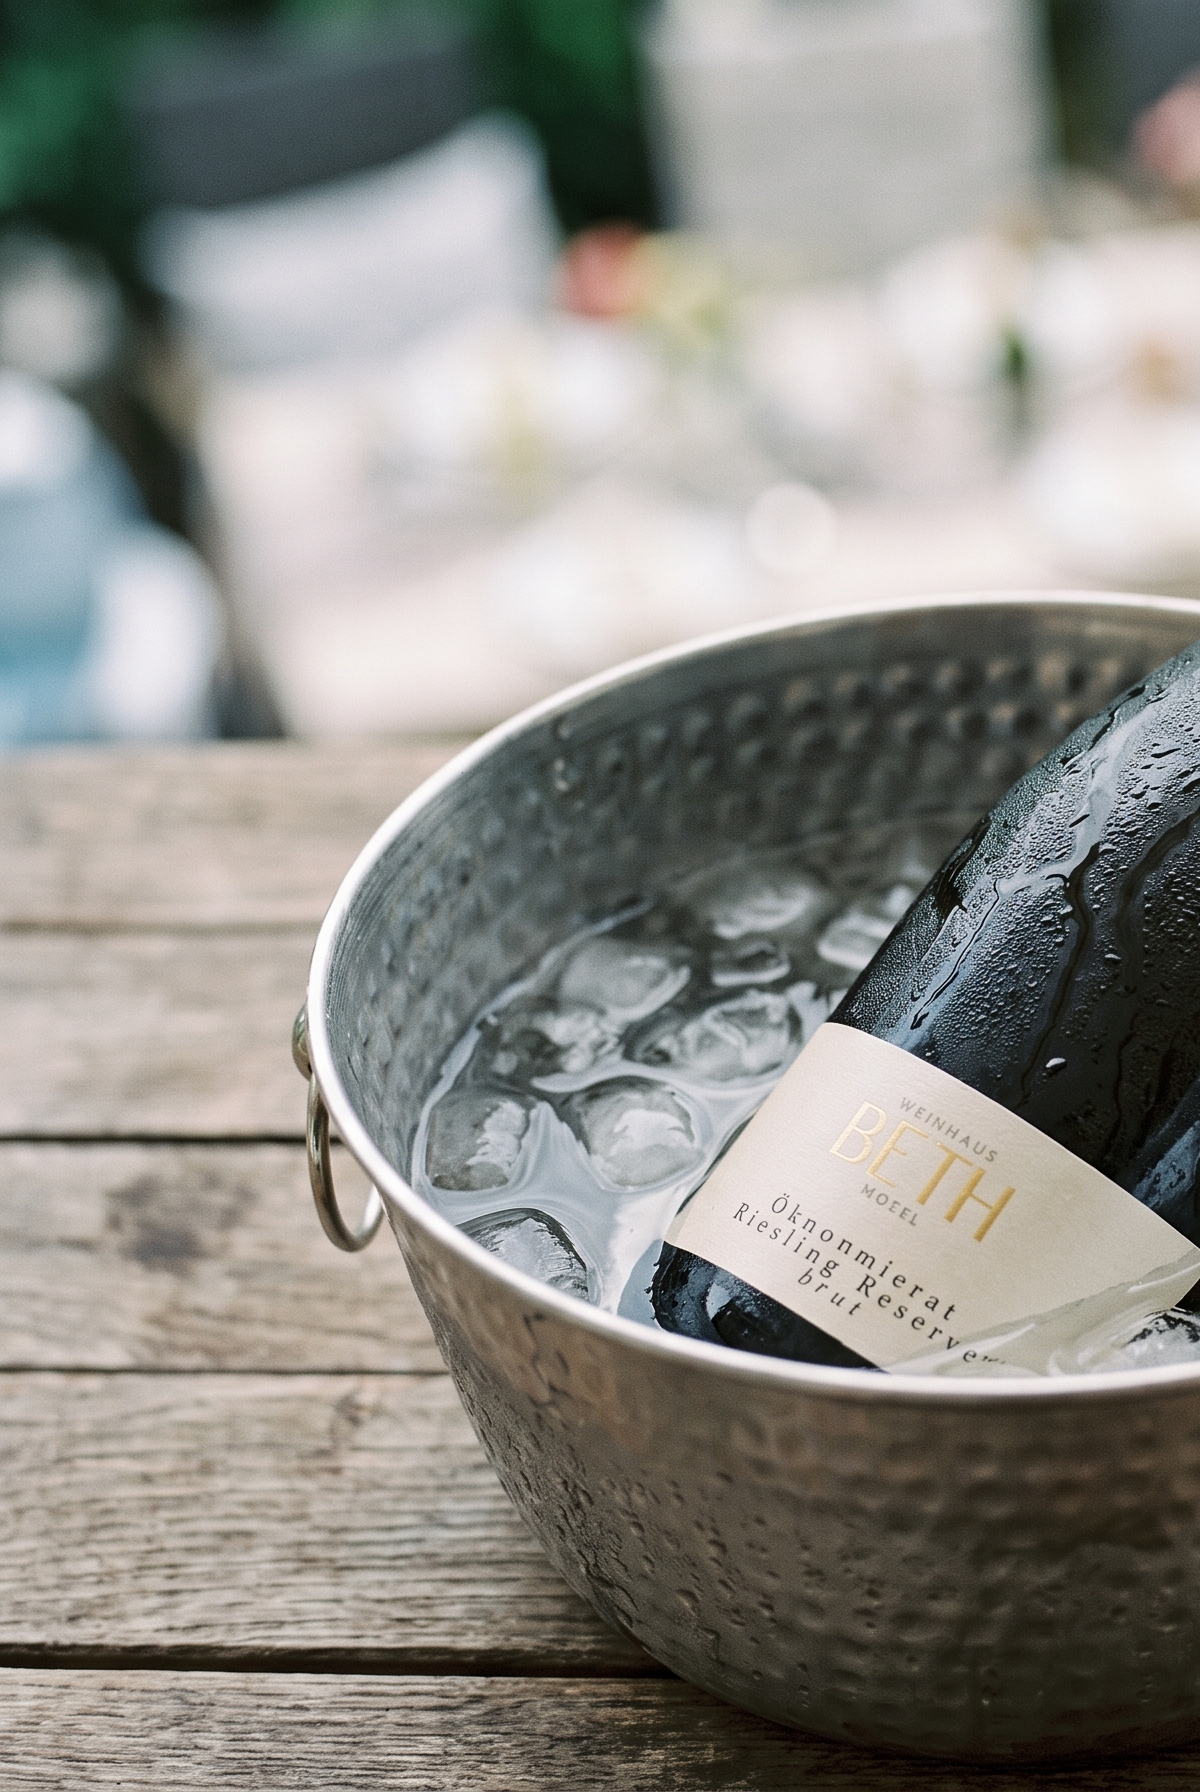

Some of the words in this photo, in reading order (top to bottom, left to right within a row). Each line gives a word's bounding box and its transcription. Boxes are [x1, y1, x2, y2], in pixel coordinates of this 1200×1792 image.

[899, 1097, 998, 1163] WEINHAUS
[829, 1100, 1017, 1243] BETH
[733, 1202, 839, 1278] Riesling
[798, 1267, 862, 1316] brut
